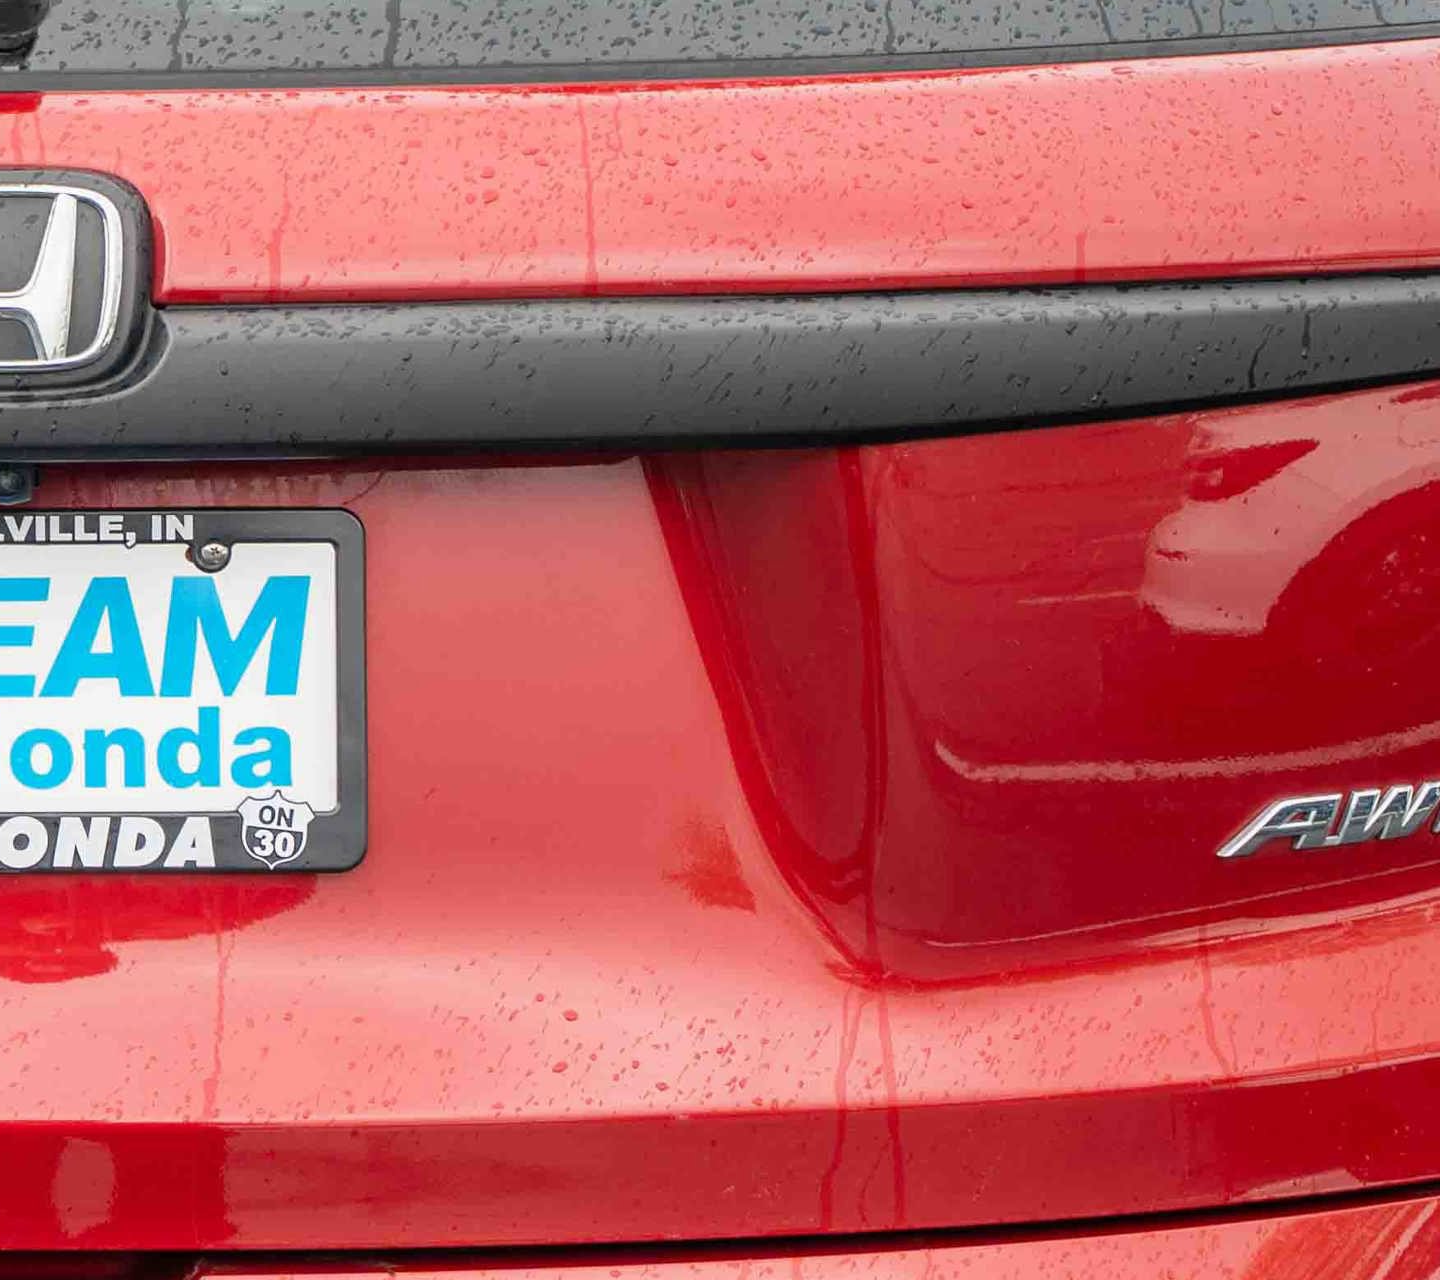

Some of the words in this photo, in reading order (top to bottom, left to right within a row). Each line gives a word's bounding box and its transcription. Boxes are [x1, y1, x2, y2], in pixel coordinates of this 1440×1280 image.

[151, 514, 194, 541] IN
[258, 805, 295, 828] ON
[252, 828, 295, 858] 30
